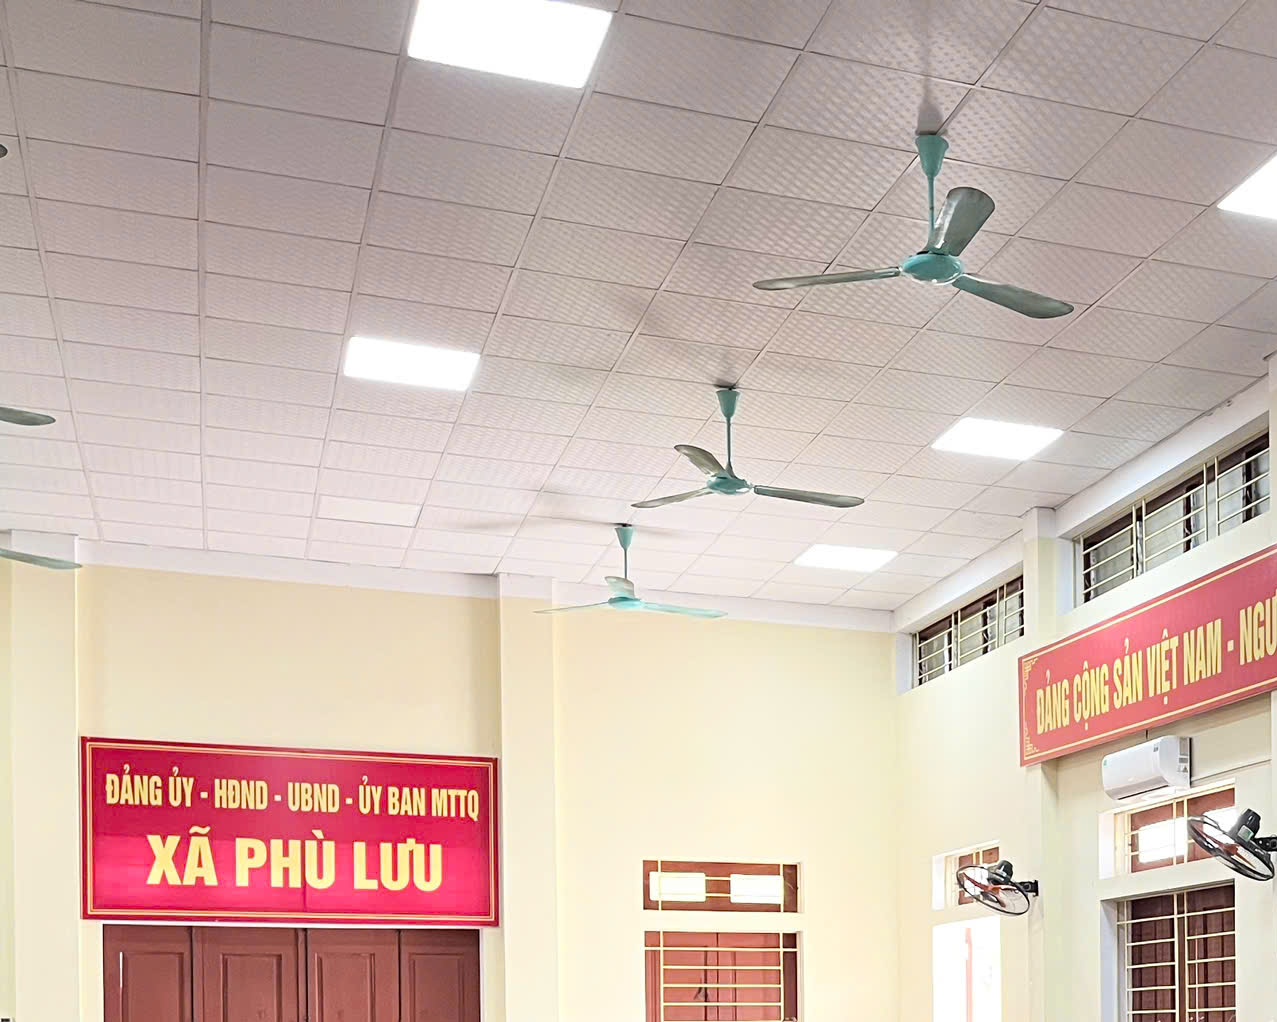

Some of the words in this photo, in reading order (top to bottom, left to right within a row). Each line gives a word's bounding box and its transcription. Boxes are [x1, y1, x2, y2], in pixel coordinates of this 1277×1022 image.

[1036, 670, 1070, 735] ĐẢNG
[1073, 660, 1109, 730] CỘNG
[1113, 638, 1143, 709] SẢN
[1146, 628, 1179, 704] VIỆT
[1183, 619, 1222, 686] NAM
[106, 764, 162, 805] ĐẢNG
[168, 766, 194, 807] ỦY
[214, 778, 268, 810] HĐND
[288, 782, 340, 813] UBND
[358, 775, 383, 815] ỦY
[387, 786, 426, 816] BAN
[431, 788, 480, 821] MTTQ
[146, 825, 218, 886] XÃ
[235, 829, 336, 889] PHÙ
[353, 838, 443, 891] LƯU
